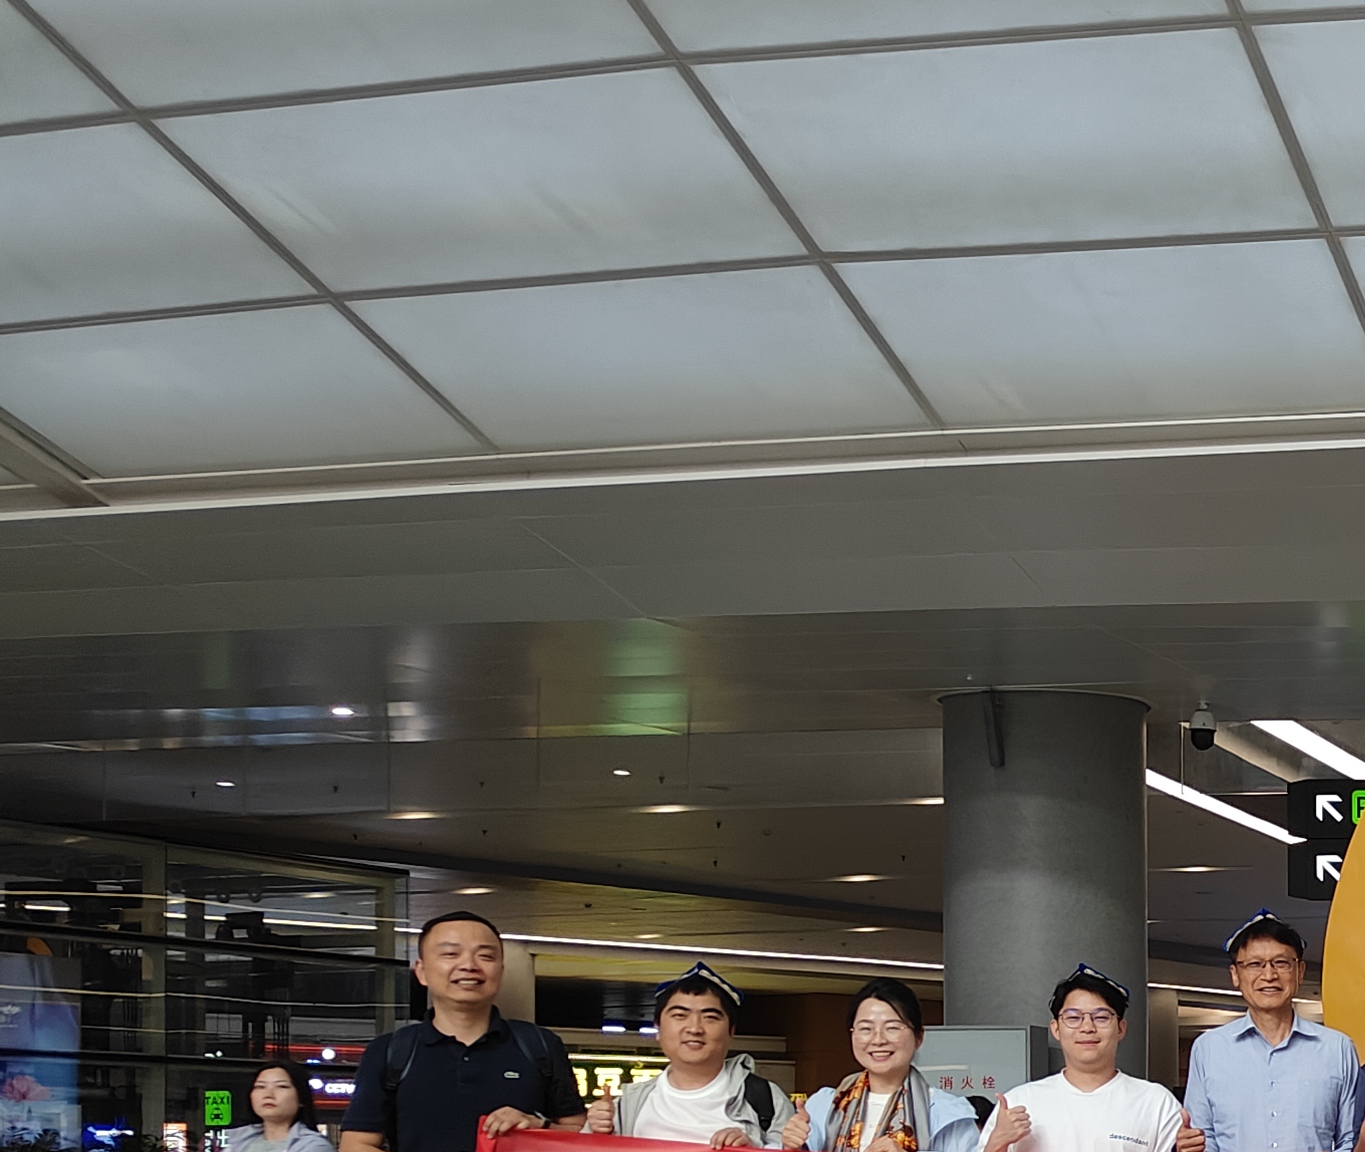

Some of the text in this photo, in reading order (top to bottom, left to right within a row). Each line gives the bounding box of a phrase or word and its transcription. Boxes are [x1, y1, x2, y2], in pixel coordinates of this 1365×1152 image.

[938, 1075, 996, 1091] 消火栓
[205, 1096, 231, 1105] TAXI
